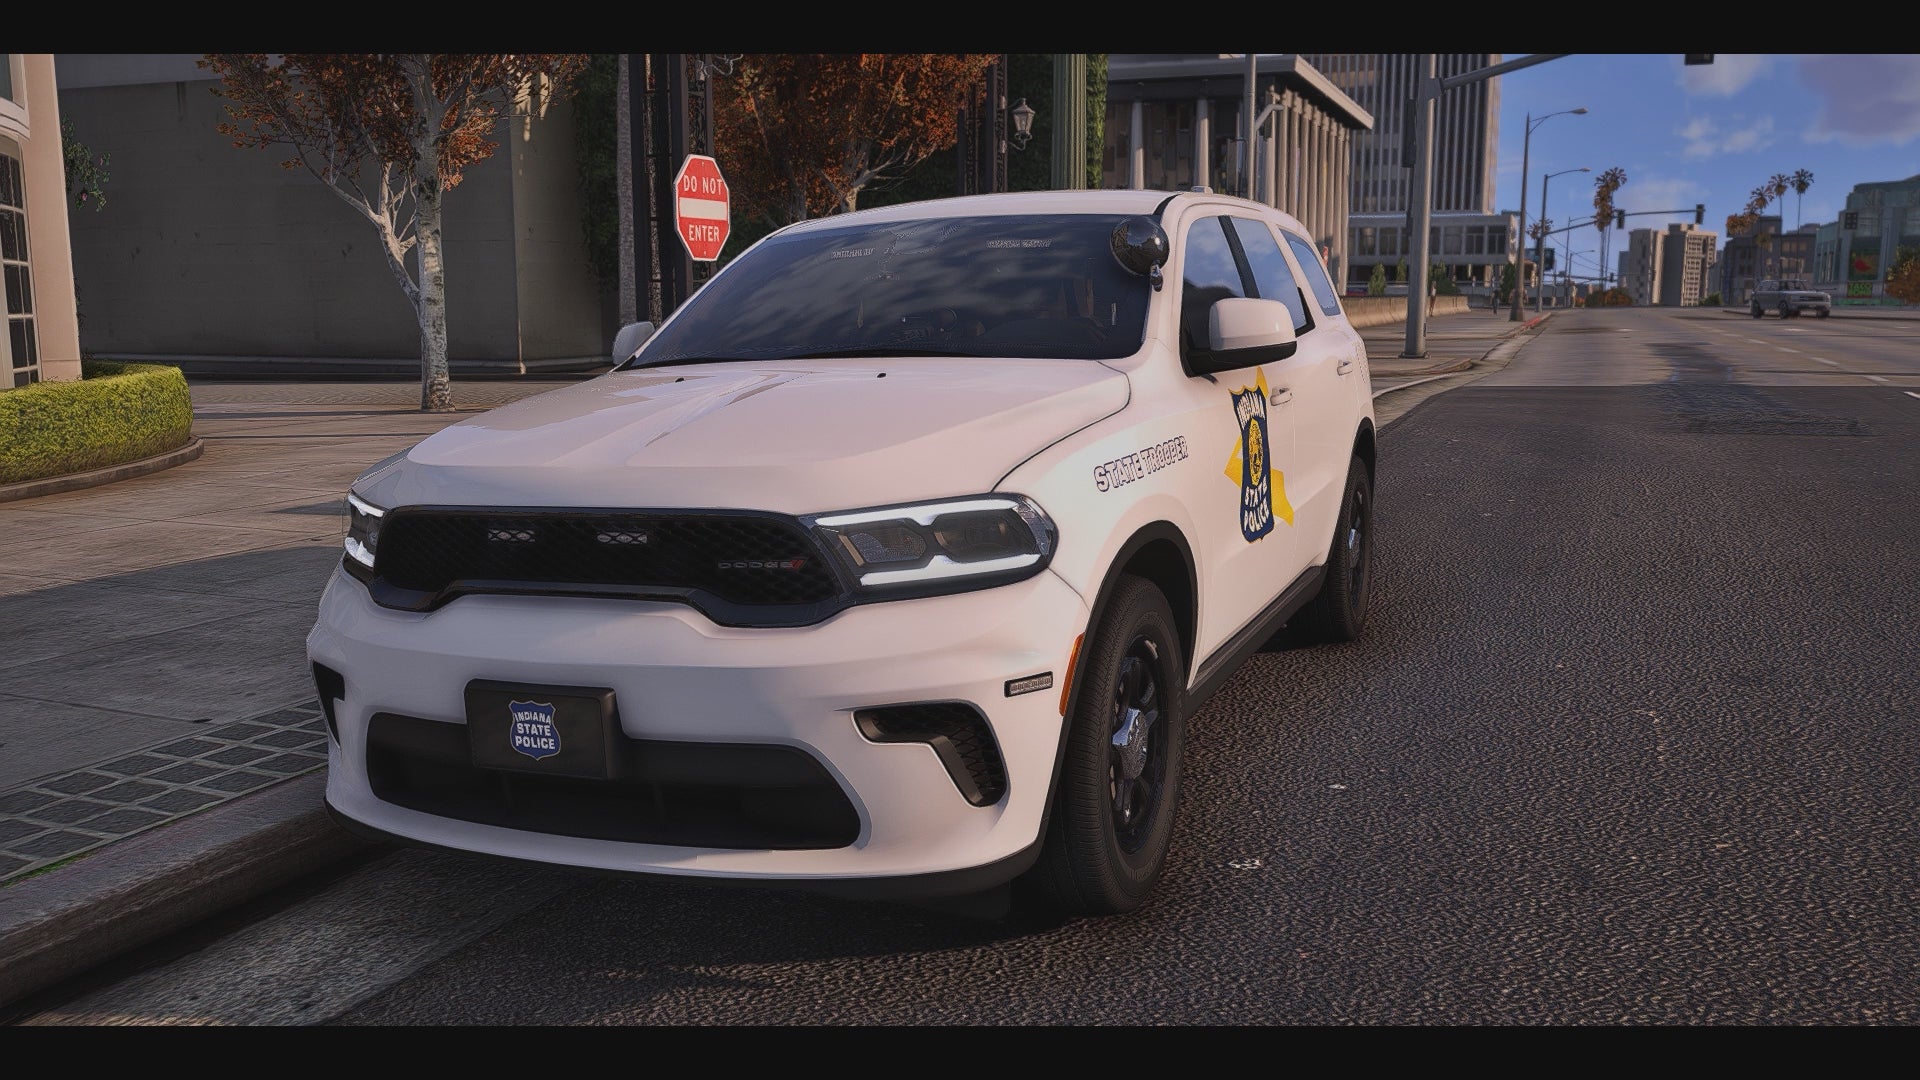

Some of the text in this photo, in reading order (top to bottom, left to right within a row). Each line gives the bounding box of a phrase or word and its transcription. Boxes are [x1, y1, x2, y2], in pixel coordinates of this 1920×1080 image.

[683, 175, 723, 195] DO NOT
[688, 224, 720, 243] ENTER
[1093, 435, 1189, 493] STATE TROOPER
[1244, 474, 1268, 508] STATE
[1243, 496, 1270, 533] POLICE
[514, 711, 552, 726] INDIANA
[516, 723, 552, 737] STATE
[515, 735, 556, 750] POLICE
